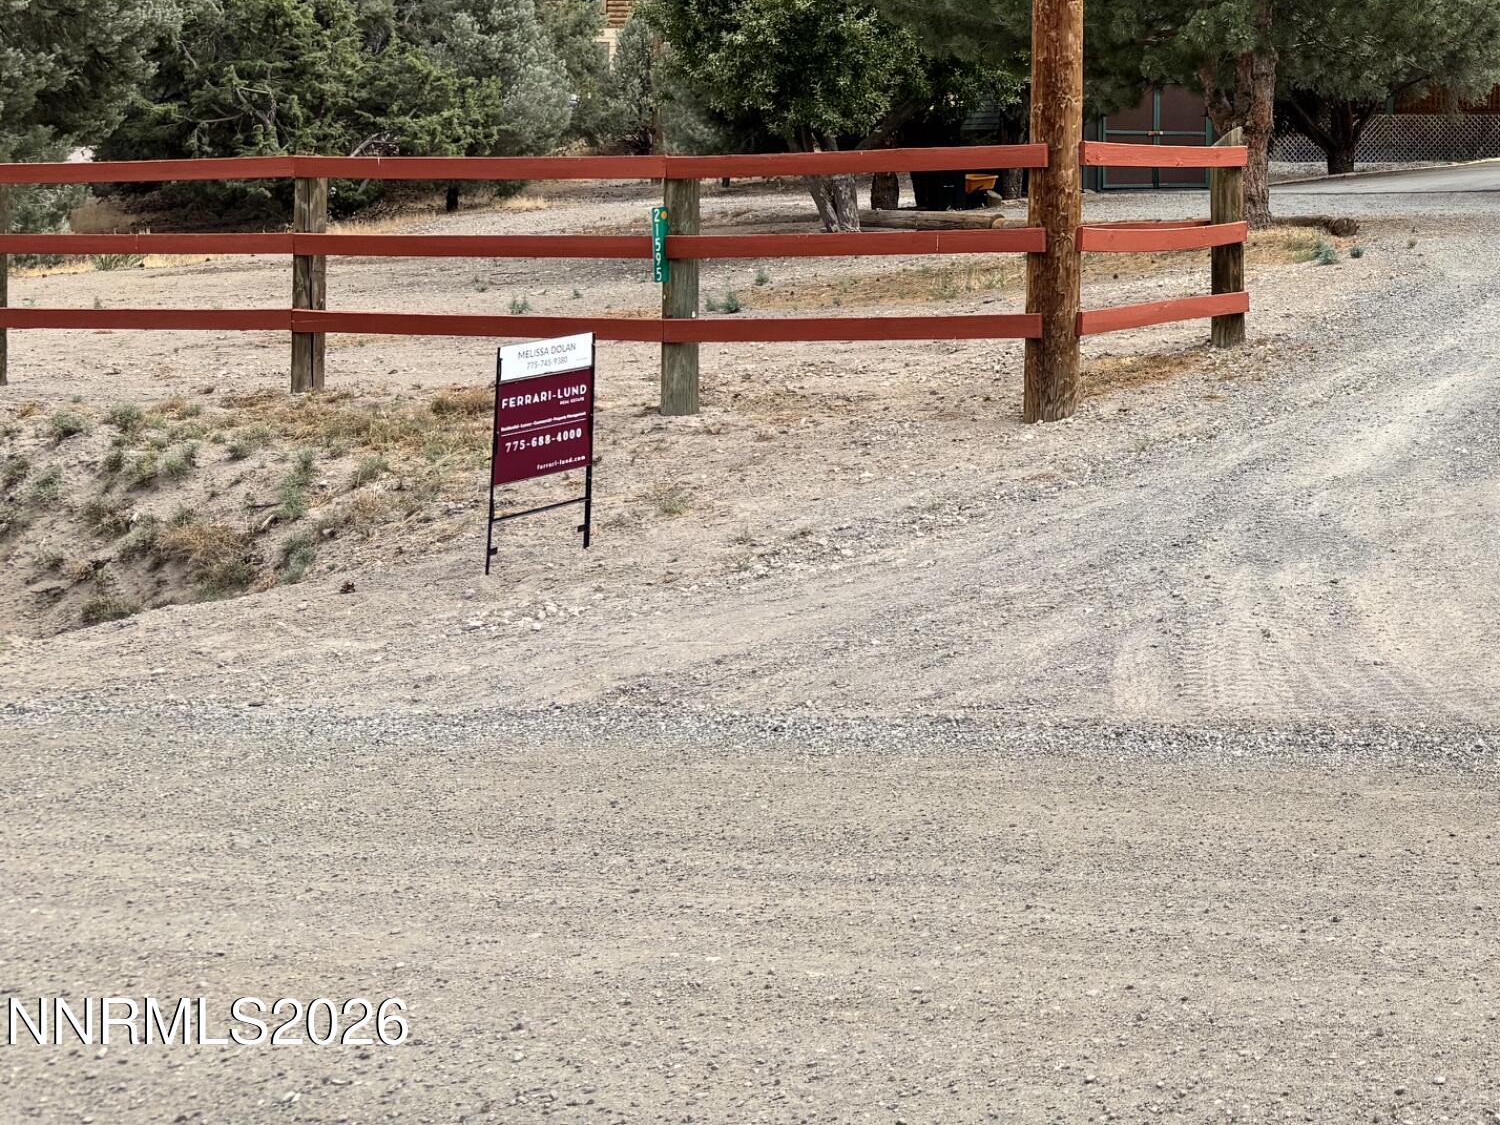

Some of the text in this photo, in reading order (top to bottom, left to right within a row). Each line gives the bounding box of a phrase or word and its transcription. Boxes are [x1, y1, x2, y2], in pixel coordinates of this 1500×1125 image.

[653, 208, 662, 281] 21595
[517, 342, 577, 360] MELISSA DOLAN
[501, 384, 587, 409] FERRARI-LUND
[505, 428, 582, 454] 775-688-4000
[536, 455, 586, 471] ferrari-lund.com
